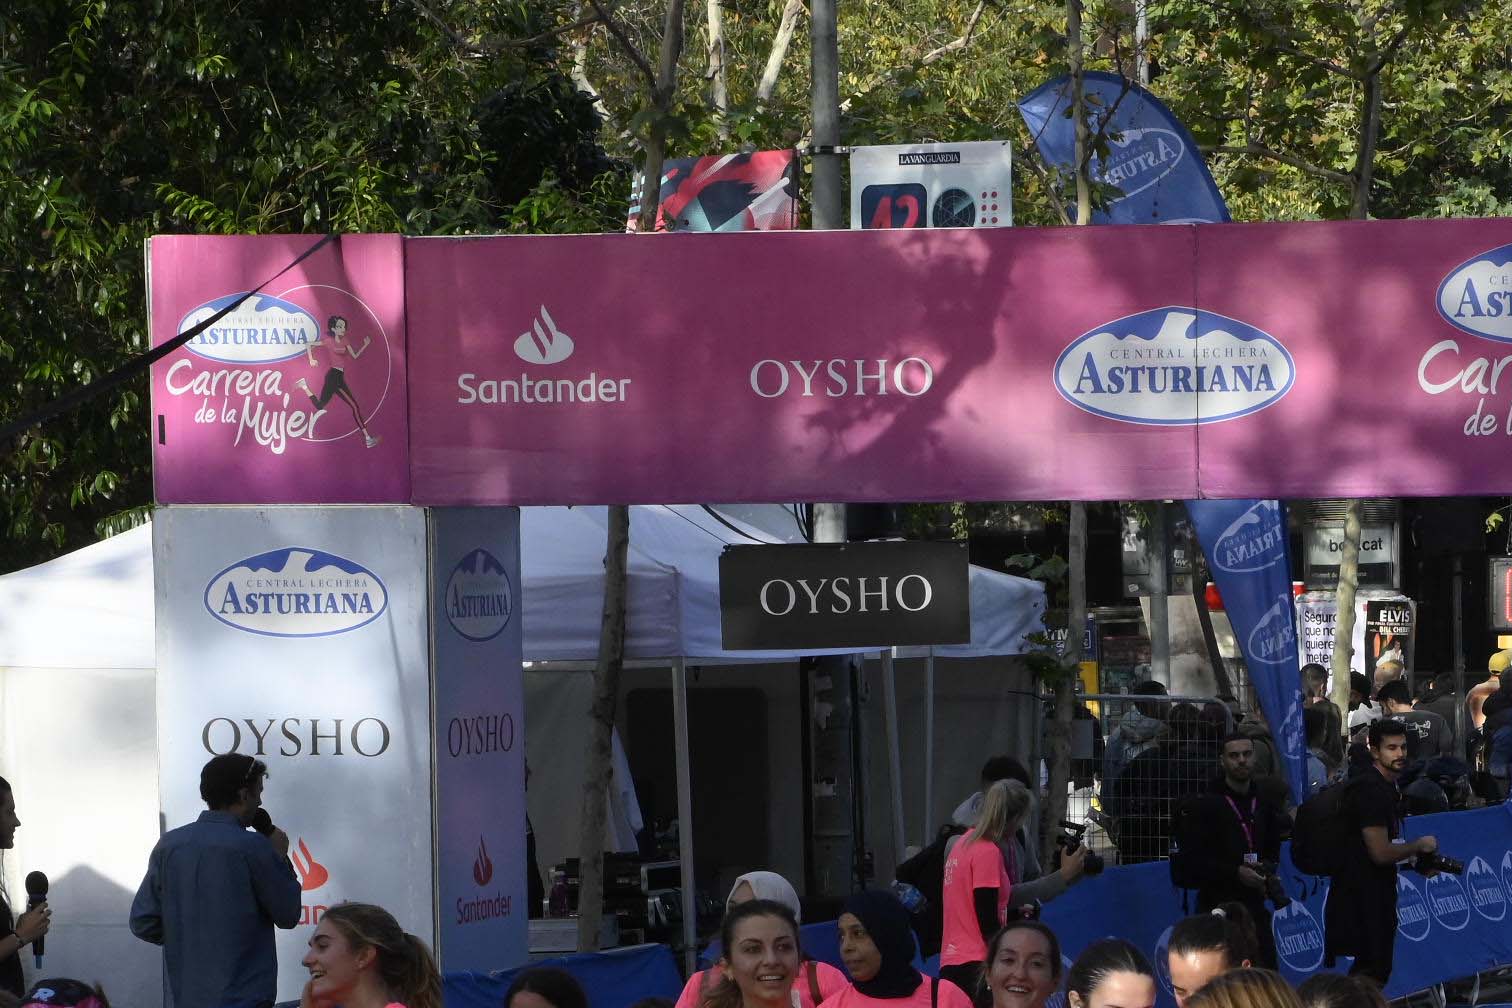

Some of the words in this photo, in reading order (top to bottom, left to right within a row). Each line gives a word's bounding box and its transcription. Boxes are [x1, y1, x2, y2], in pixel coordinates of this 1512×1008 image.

[188, 318, 309, 345] ASTURIANA
[1110, 347, 1185, 360] CENTRAL
[1192, 346, 1269, 359] LECHERA
[165, 358, 283, 397] Carrera
[458, 372, 632, 405] Santander
[749, 356, 934, 399] OYSHO
[1073, 350, 1277, 395] ASTURIANA
[194, 397, 217, 424] de
[221, 397, 237, 424] la
[233, 392, 328, 455] Mujer
[1463, 399, 1497, 438] de
[1330, 537, 1383, 552] b.cat
[219, 581, 375, 615] ASTURIANA
[246, 579, 305, 588] CENTRAL
[310, 578, 369, 588] LECHERA
[450, 580, 510, 619] ASTURIANA
[760, 574, 933, 617] OYSHO
[1305, 627, 1321, 638] que
[1379, 610, 1410, 622] ELVIS
[1305, 638, 1337, 649] quiere
[1306, 651, 1333, 663] mete
[201, 716, 391, 758] OYSHO
[448, 713, 514, 758] OYSHO
[456, 895, 512, 926] Santander
